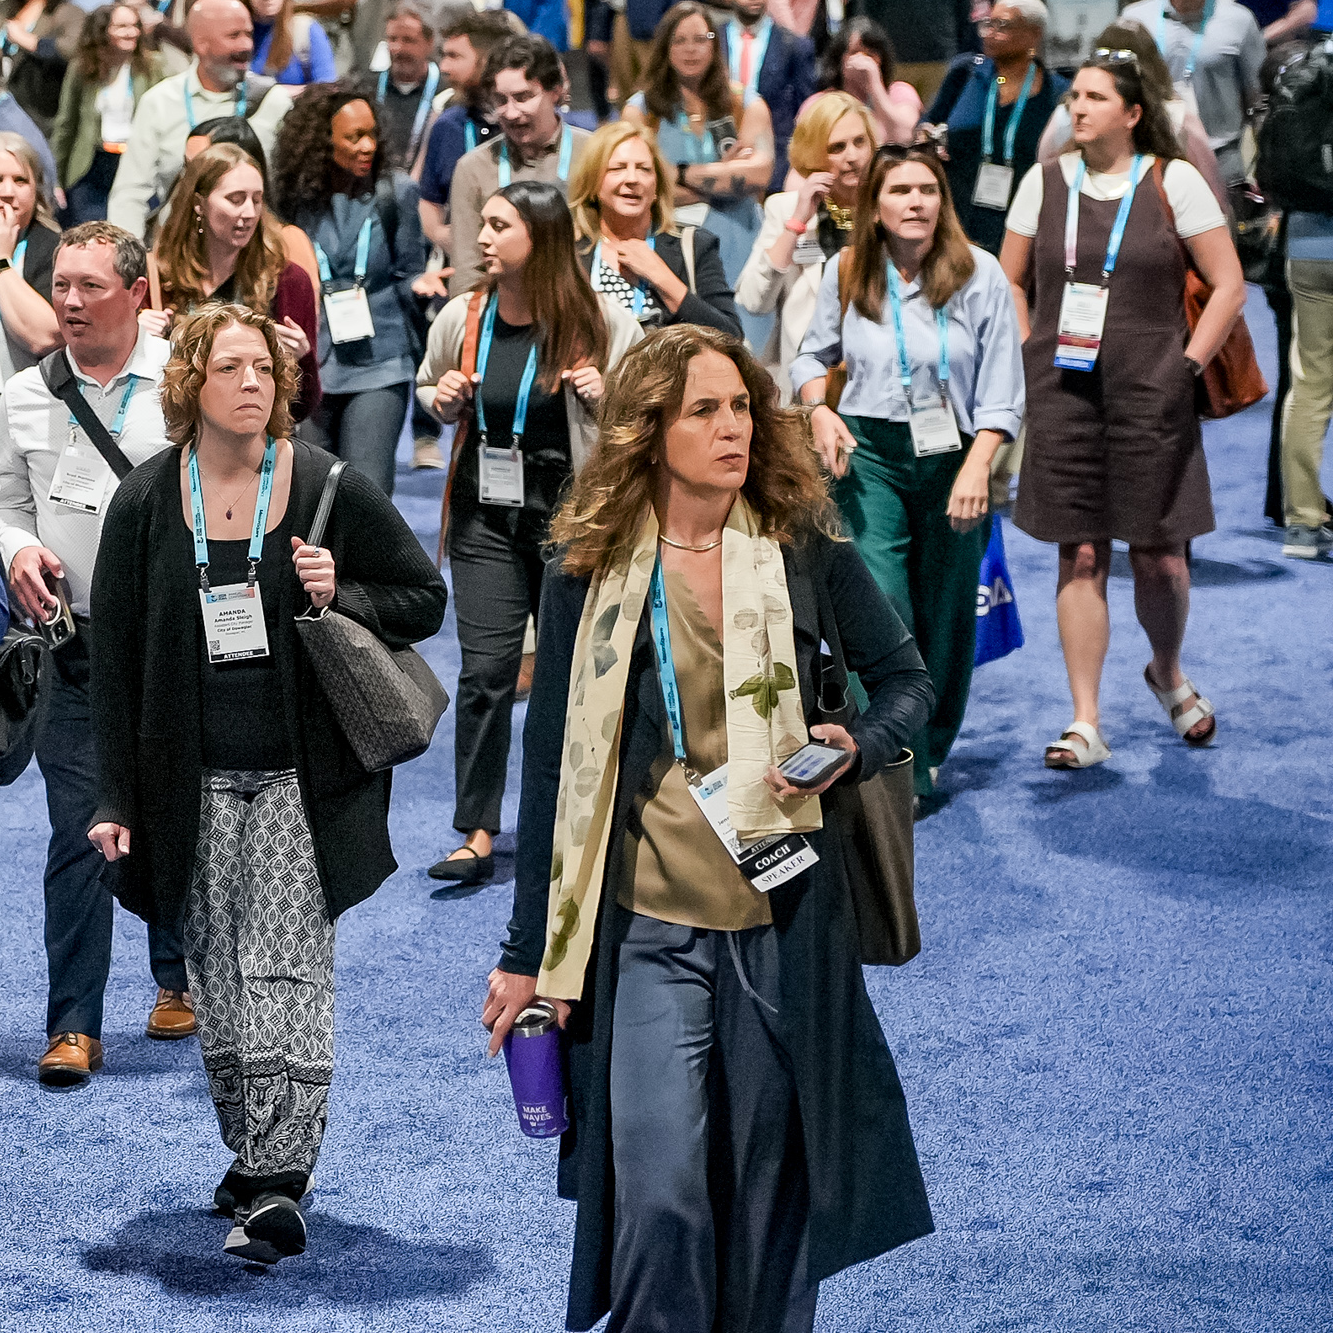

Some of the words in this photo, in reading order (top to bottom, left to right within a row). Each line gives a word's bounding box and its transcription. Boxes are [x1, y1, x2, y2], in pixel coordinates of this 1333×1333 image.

[219, 609, 246, 617] AMANDA
[223, 651, 254, 659] ATTENDEE
[754, 844, 792, 871] COACH
[761, 854, 806, 885] SPEAKER
[522, 1105, 547, 1114] MAKE
